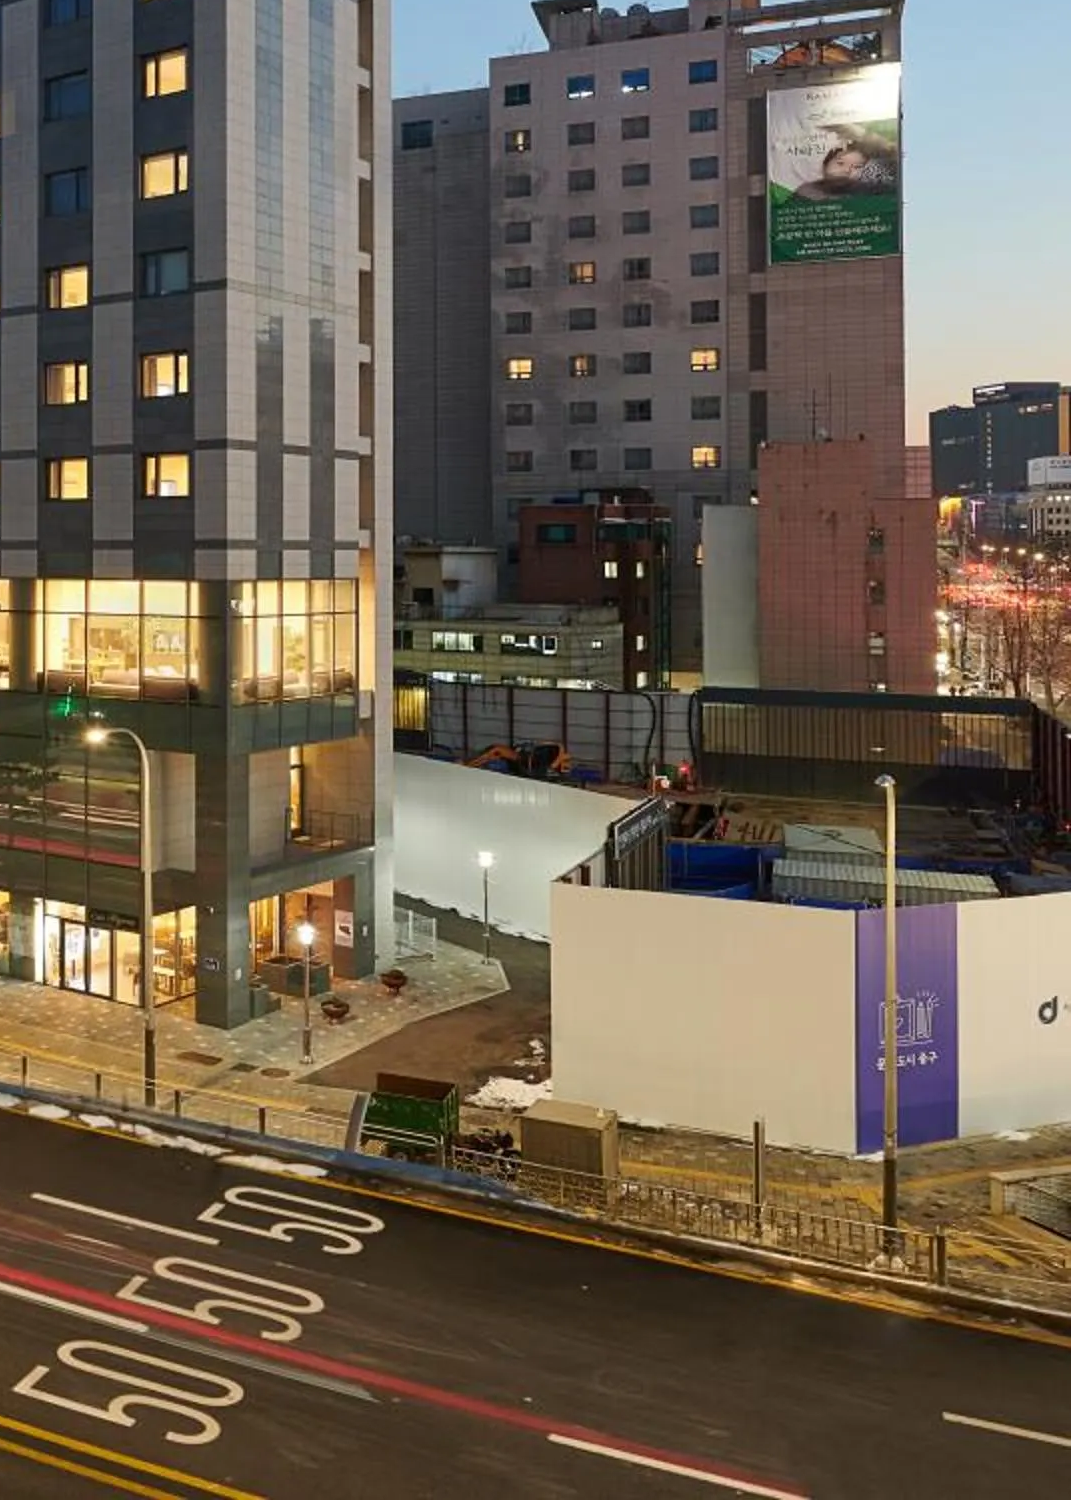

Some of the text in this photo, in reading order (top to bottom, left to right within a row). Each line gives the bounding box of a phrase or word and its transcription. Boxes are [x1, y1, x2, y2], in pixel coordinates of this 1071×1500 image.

[196, 1185, 386, 1255] 50
[115, 1256, 326, 1342] 50
[12, 1339, 245, 1445] 50
